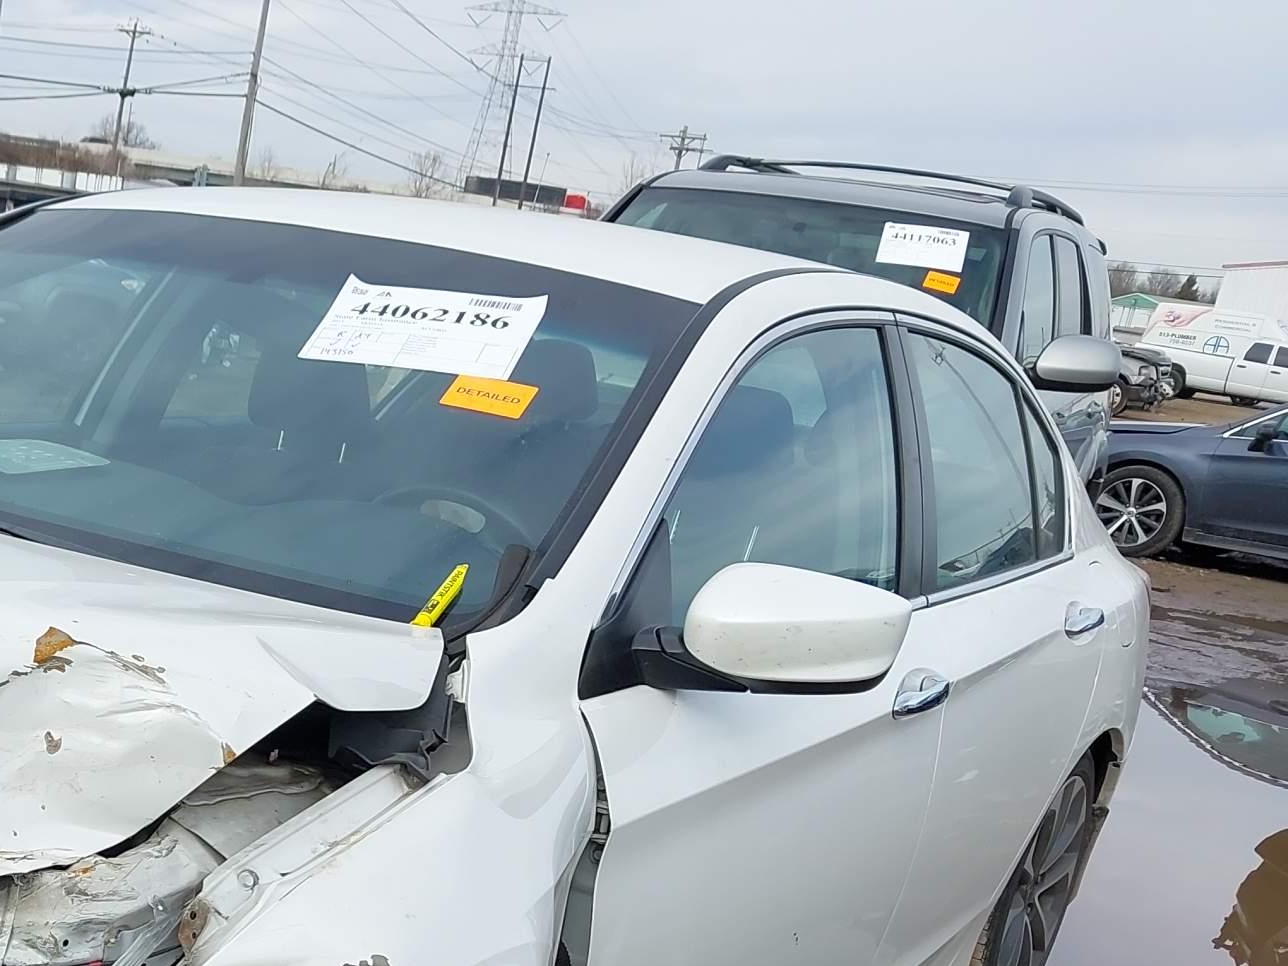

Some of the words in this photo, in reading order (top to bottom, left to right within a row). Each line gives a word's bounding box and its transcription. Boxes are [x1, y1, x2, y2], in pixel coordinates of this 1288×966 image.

[891, 232, 956, 246] 44117063
[351, 302, 513, 330] 44062186
[456, 386, 521, 405] DETAILED
